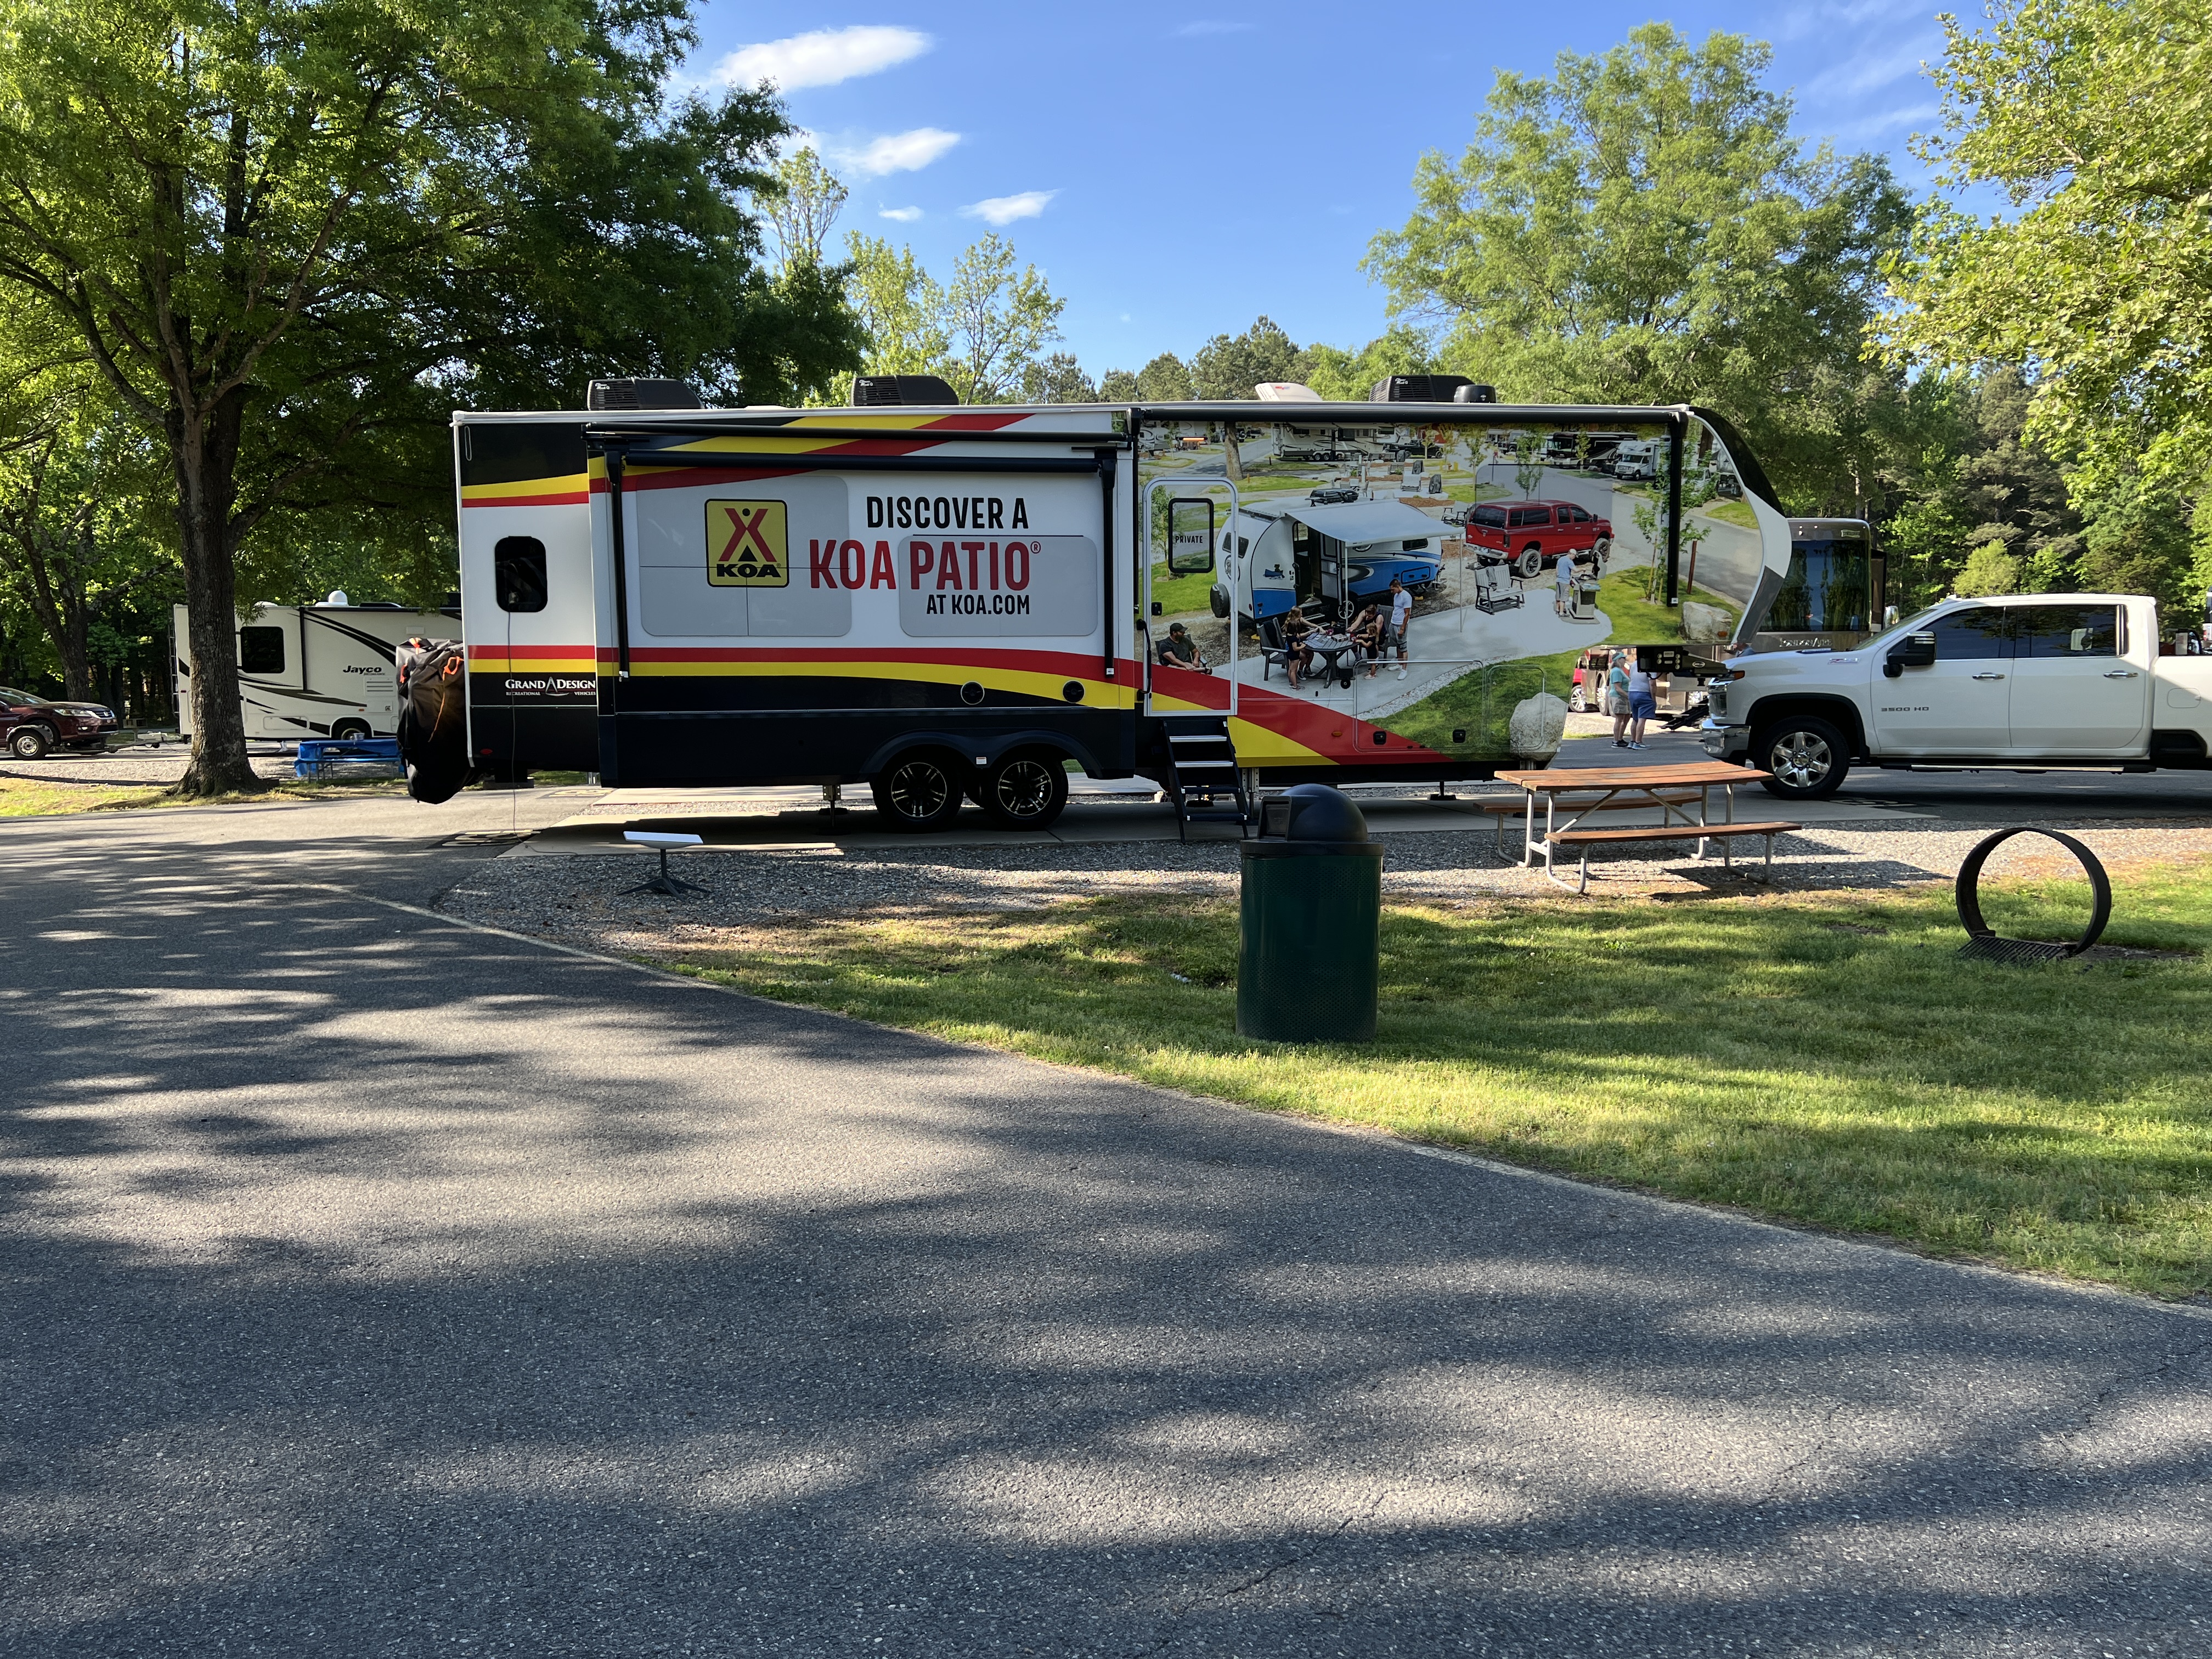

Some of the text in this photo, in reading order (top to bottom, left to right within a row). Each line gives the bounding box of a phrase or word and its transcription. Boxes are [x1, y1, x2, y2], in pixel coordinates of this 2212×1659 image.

[866, 496, 1029, 529] DISCOVER A
[716, 563, 781, 578] KOA
[809, 539, 896, 590] KOA
[926, 594, 1030, 615] AT KOA.COM
[343, 665, 382, 674] Jayco
